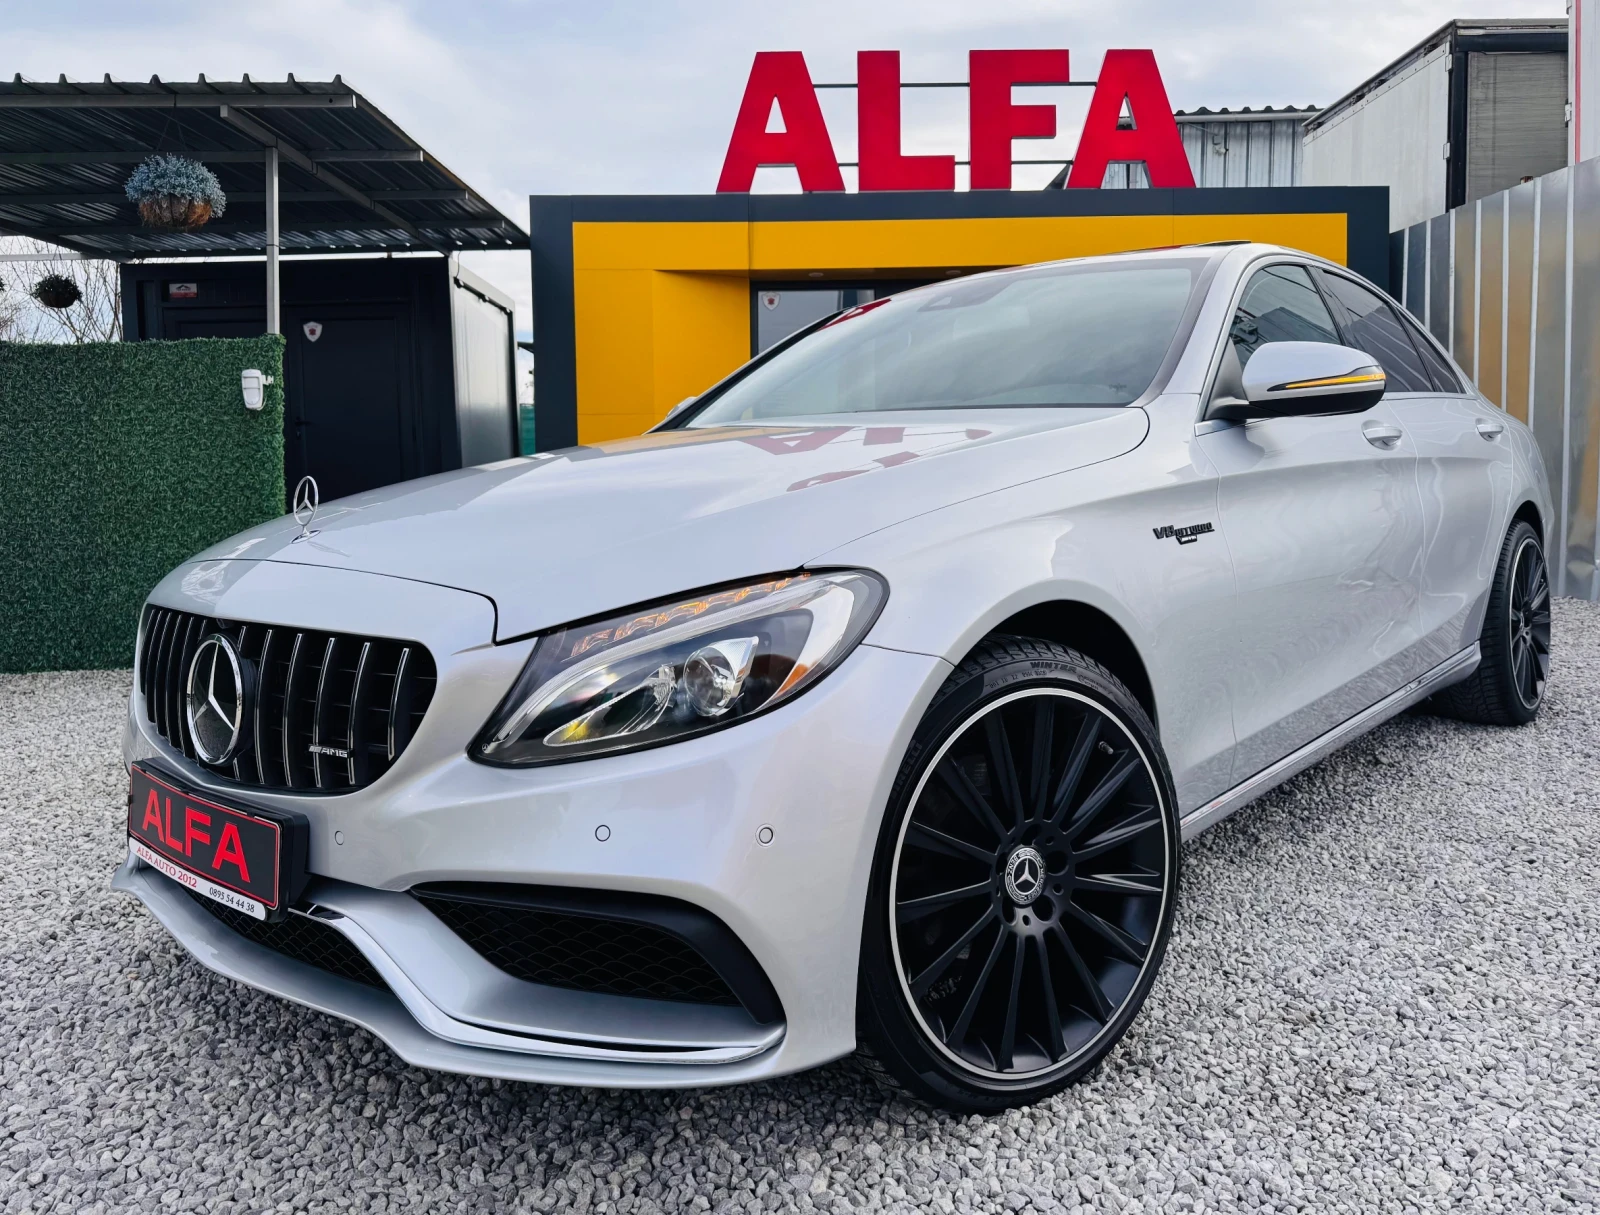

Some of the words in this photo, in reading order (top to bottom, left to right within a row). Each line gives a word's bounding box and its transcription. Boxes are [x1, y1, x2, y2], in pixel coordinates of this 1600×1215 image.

[716, 49, 1197, 193] ALFA
[1030, 661, 1077, 673] WINTER
[320, 747, 348, 758] AMG
[142, 788, 250, 883] ALFA
[136, 846, 153, 863] ALFA
[153, 860, 177, 877] AUTO
[178, 870, 198, 888] 2012
[209, 886, 225, 901] 0895
[225, 895, 235, 905] 54
[235, 899, 245, 909] 44
[246, 902, 255, 913] 38
